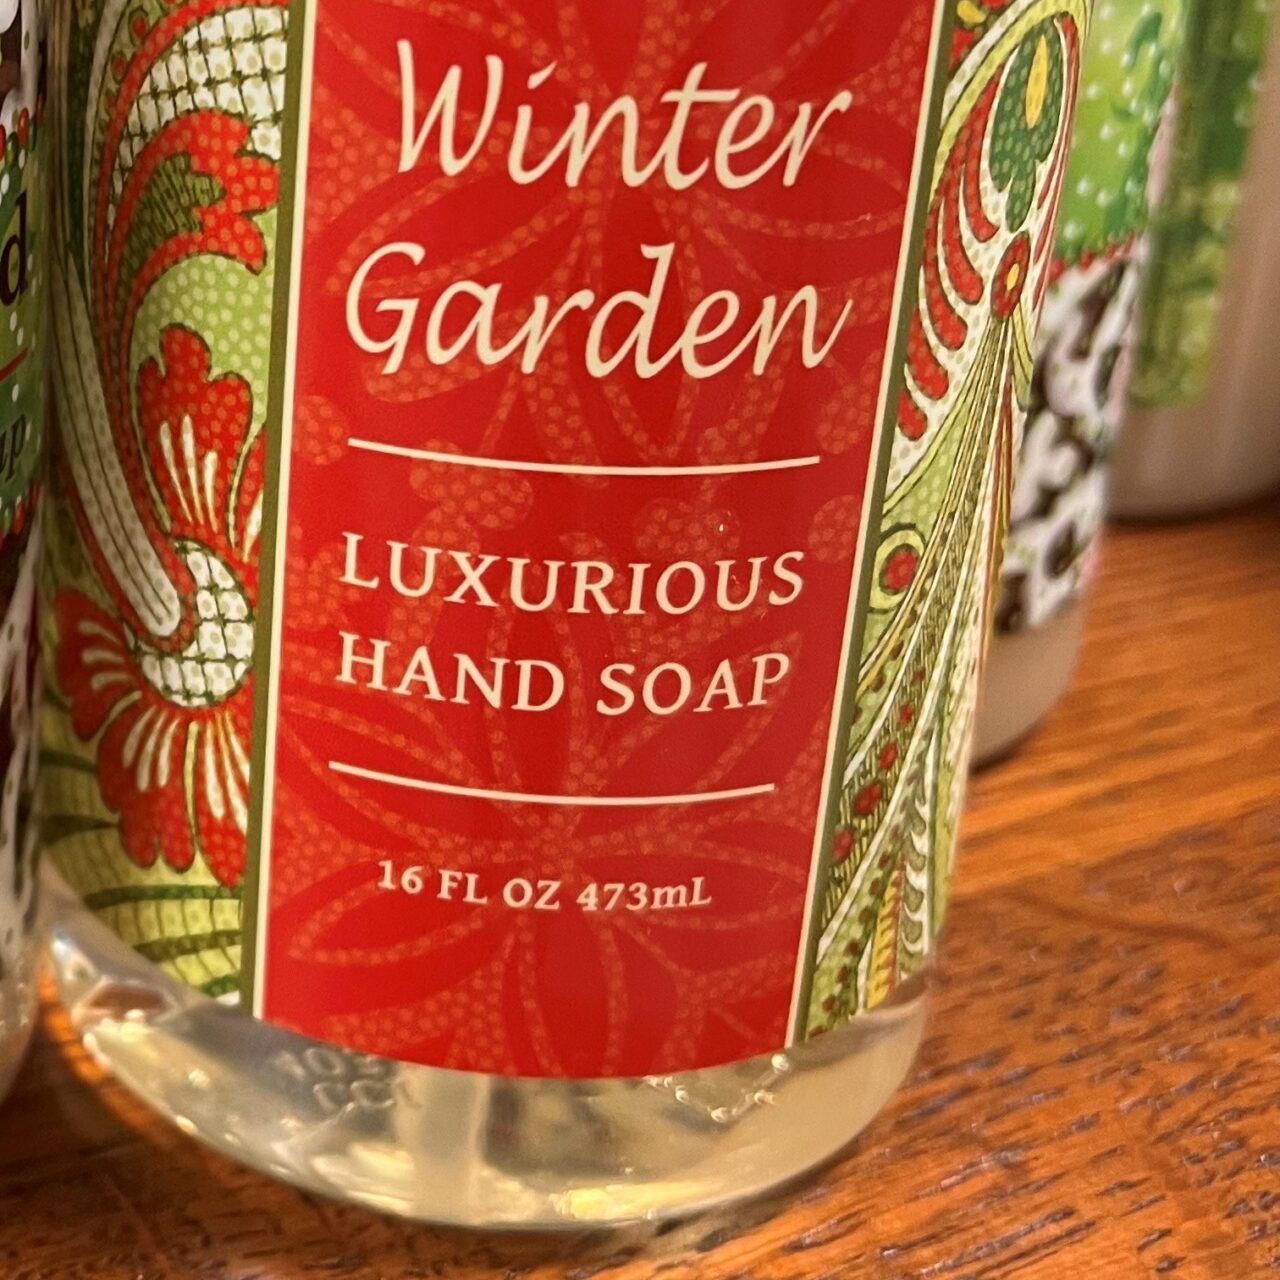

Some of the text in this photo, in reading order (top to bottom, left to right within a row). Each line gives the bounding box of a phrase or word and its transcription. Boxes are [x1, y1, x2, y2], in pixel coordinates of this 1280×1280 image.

[396, 38, 853, 190] Winter
[345, 241, 854, 380] Garden
[339, 531, 806, 616] LUXURIOUS
[335, 631, 790, 717] HAND SOAP
[377, 859, 713, 912] 16 FL OZ 473mL
